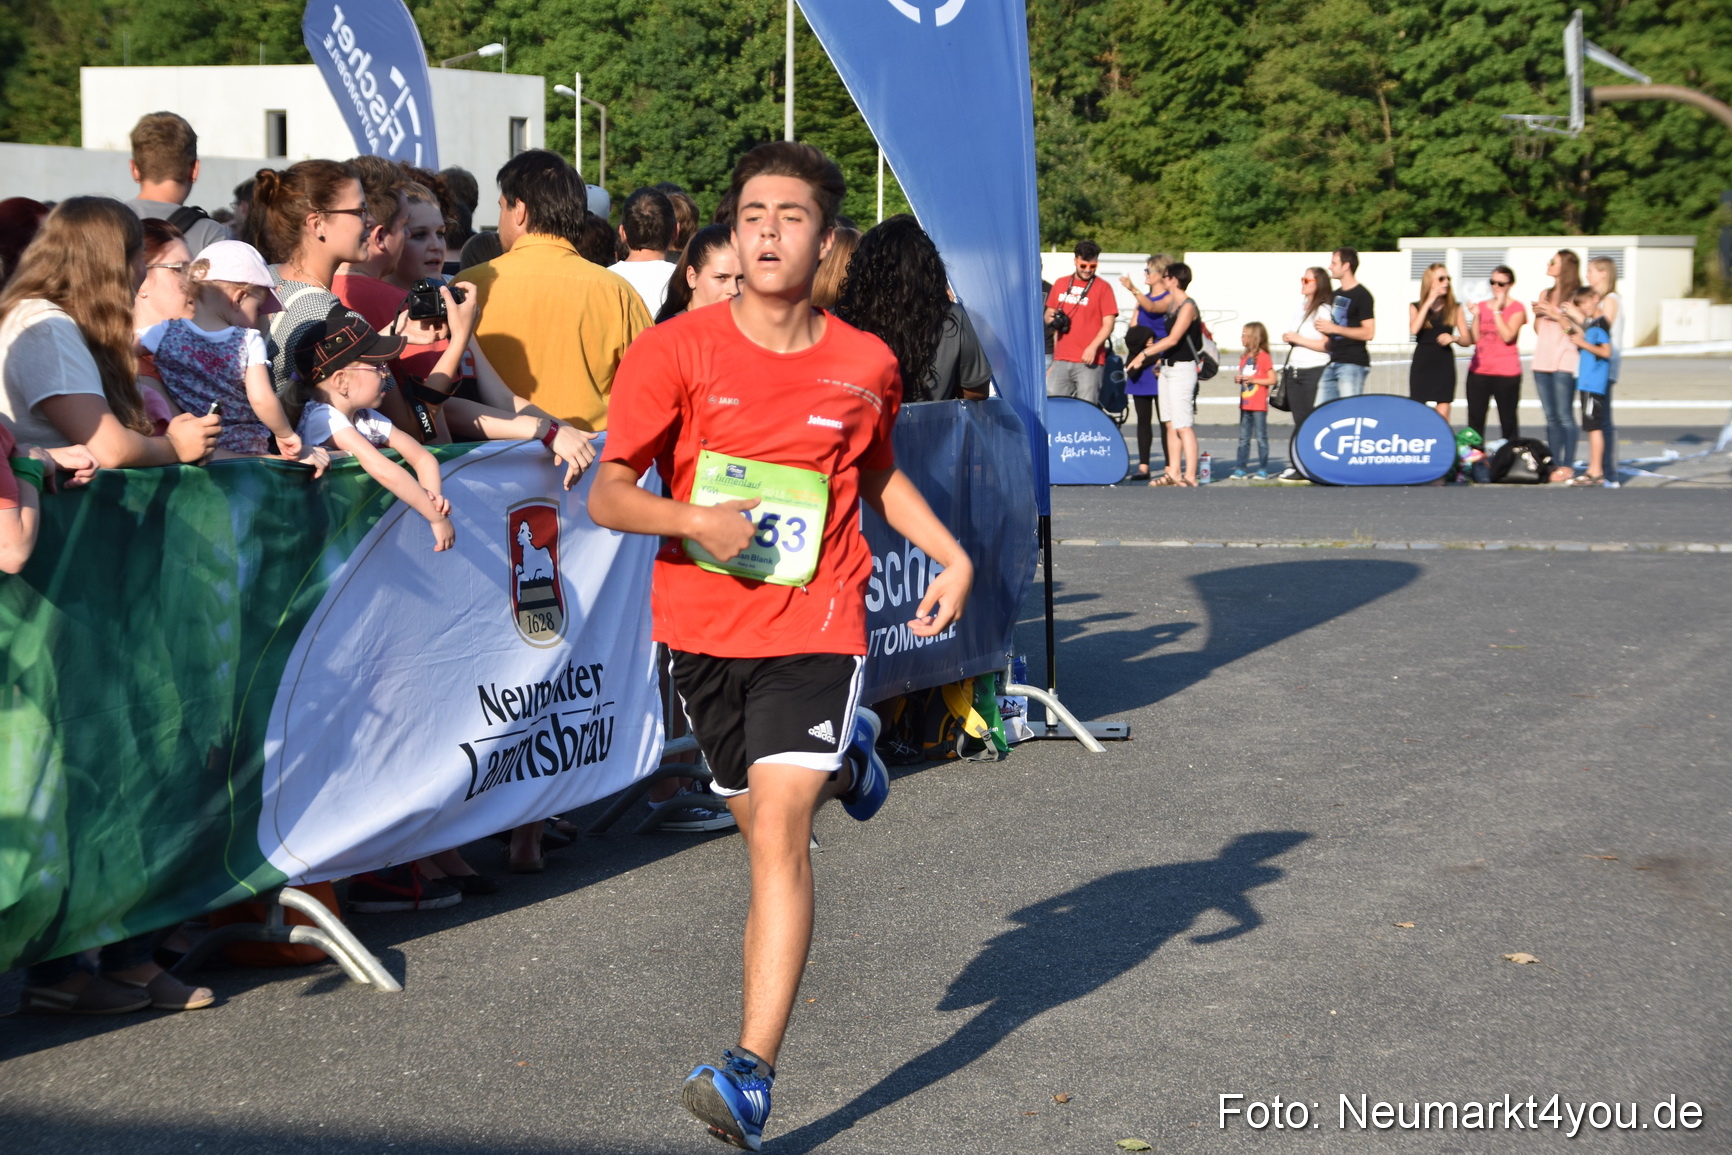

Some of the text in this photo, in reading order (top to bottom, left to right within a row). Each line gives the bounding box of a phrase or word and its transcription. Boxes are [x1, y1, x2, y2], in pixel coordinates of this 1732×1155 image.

[718, 397, 740, 406] JAKO
[415, 404, 432, 434] SONY
[807, 415, 843, 429] Johannes
[1337, 433, 1437, 455] Fischer
[1347, 455, 1431, 465] AUTOMOBILE
[751, 554, 774, 565] Blank
[527, 611, 555, 634] 1628
[808, 728, 836, 745] adidas
